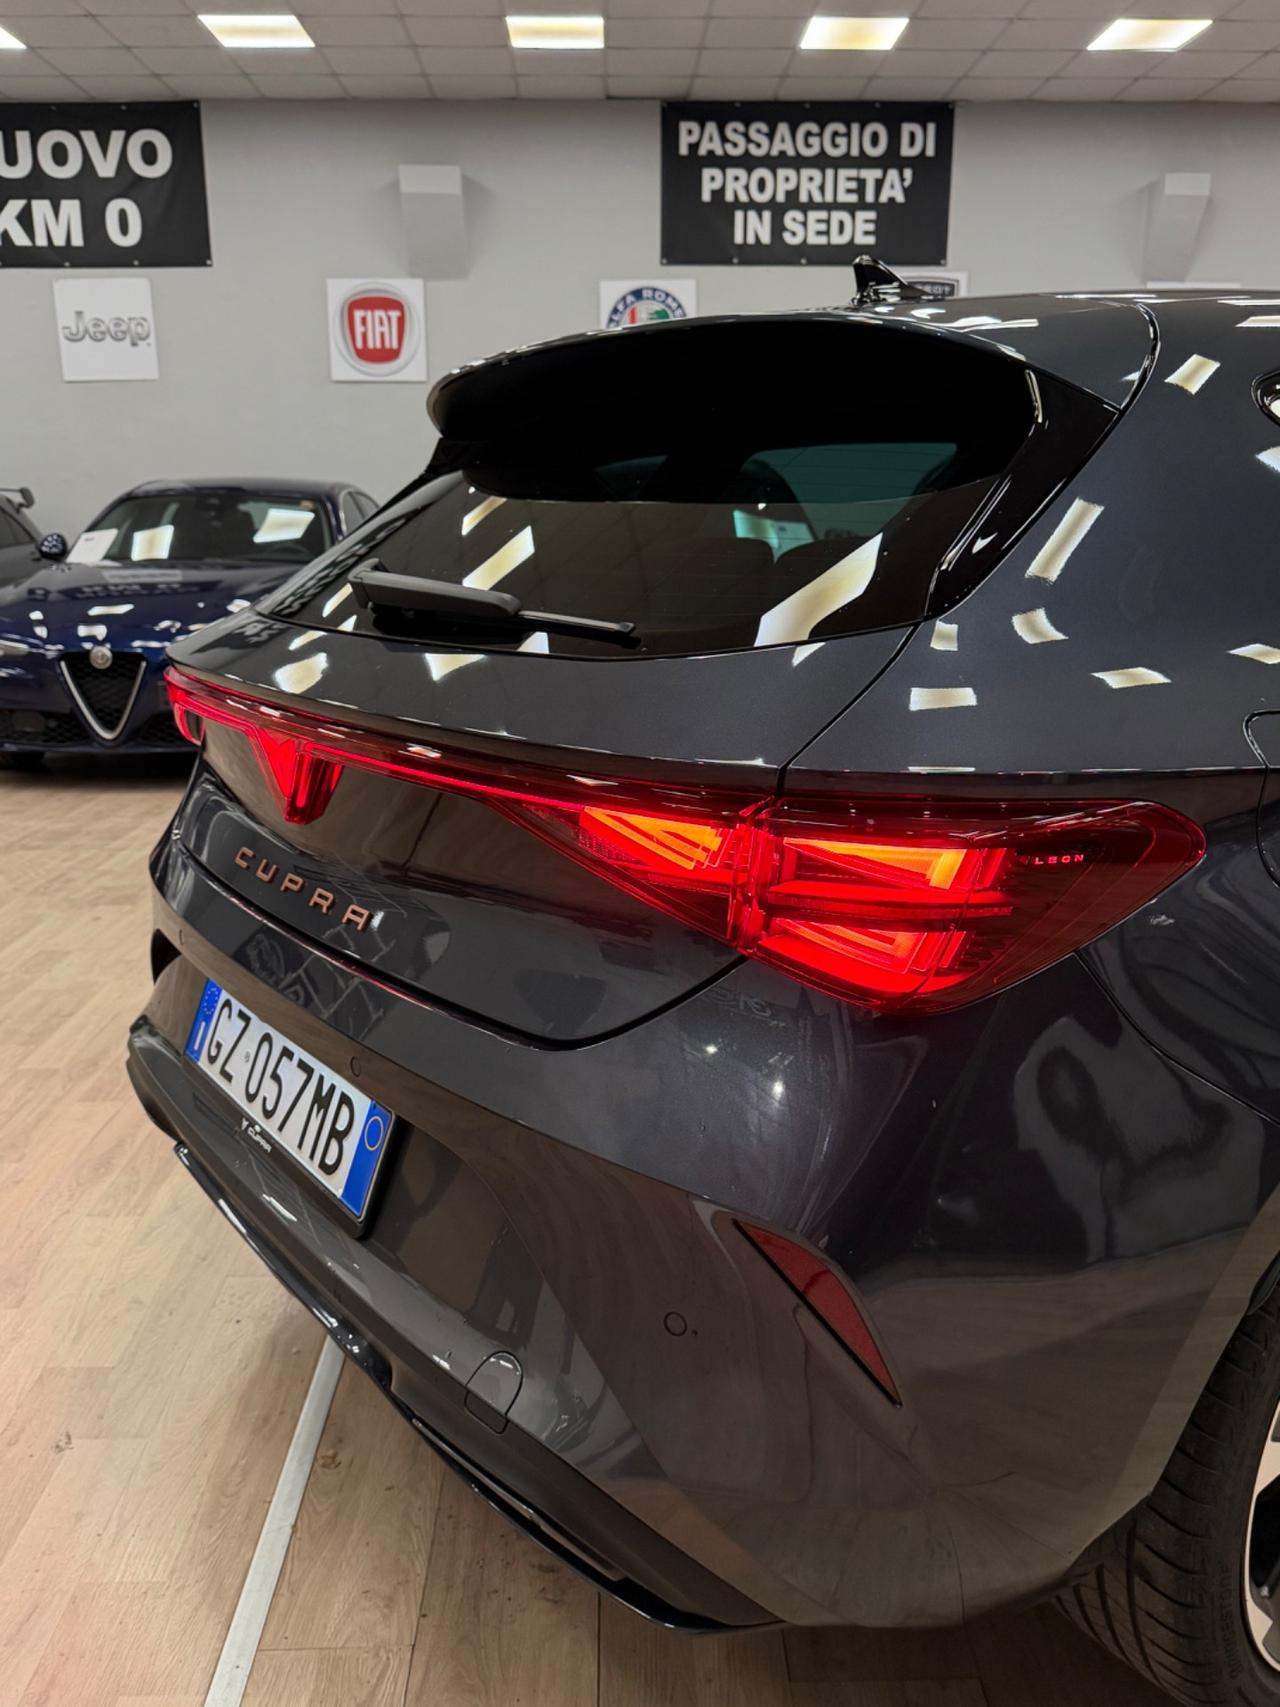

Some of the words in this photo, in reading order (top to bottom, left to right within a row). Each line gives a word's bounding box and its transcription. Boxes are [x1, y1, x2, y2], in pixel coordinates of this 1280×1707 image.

[0, 128, 173, 179] UOVO
[678, 121, 888, 157] PASSAGGIO
[900, 122, 936, 157] DI
[105, 197, 142, 247] 0
[733, 210, 771, 245] IN
[782, 210, 877, 245] SEDE
[62, 310, 151, 347] Jeep
[353, 308, 402, 350] FIAT
[1034, 854, 1084, 865] LEON
[234, 846, 370, 931] CUPRA
